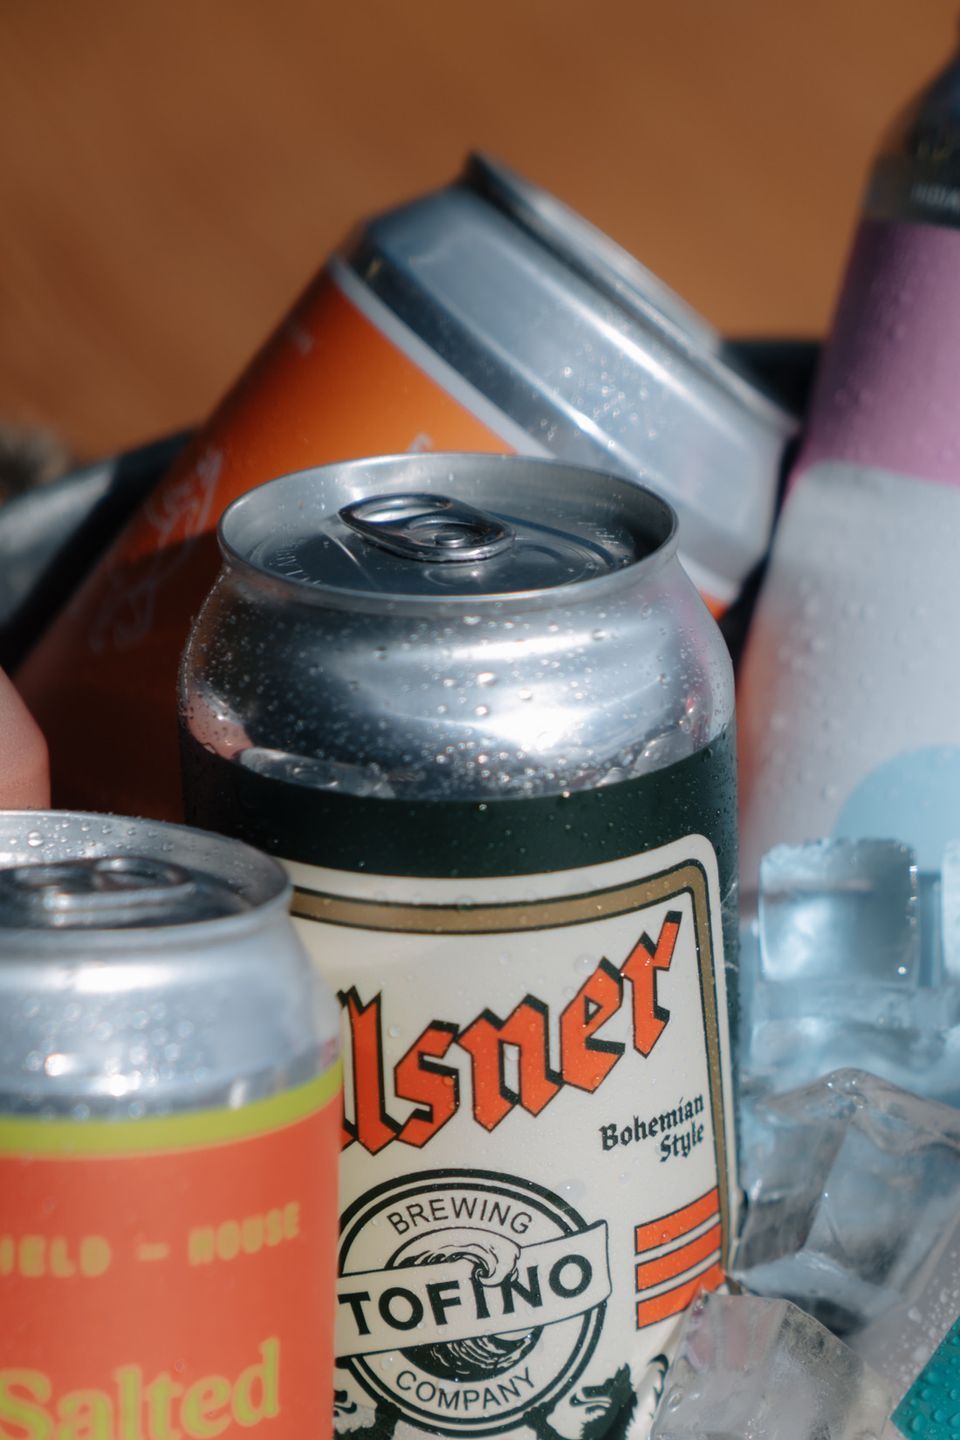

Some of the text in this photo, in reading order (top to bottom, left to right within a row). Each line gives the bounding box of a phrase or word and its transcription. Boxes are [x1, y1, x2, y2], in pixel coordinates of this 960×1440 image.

[337, 910, 683, 1157] lsner
[600, 1093, 704, 1151] Bohemian
[660, 1120, 704, 1163] Style
[387, 1197, 533, 1236] BREWING
[338, 1254, 593, 1336] TOFINO
[396, 1366, 535, 1411] COMPANY
